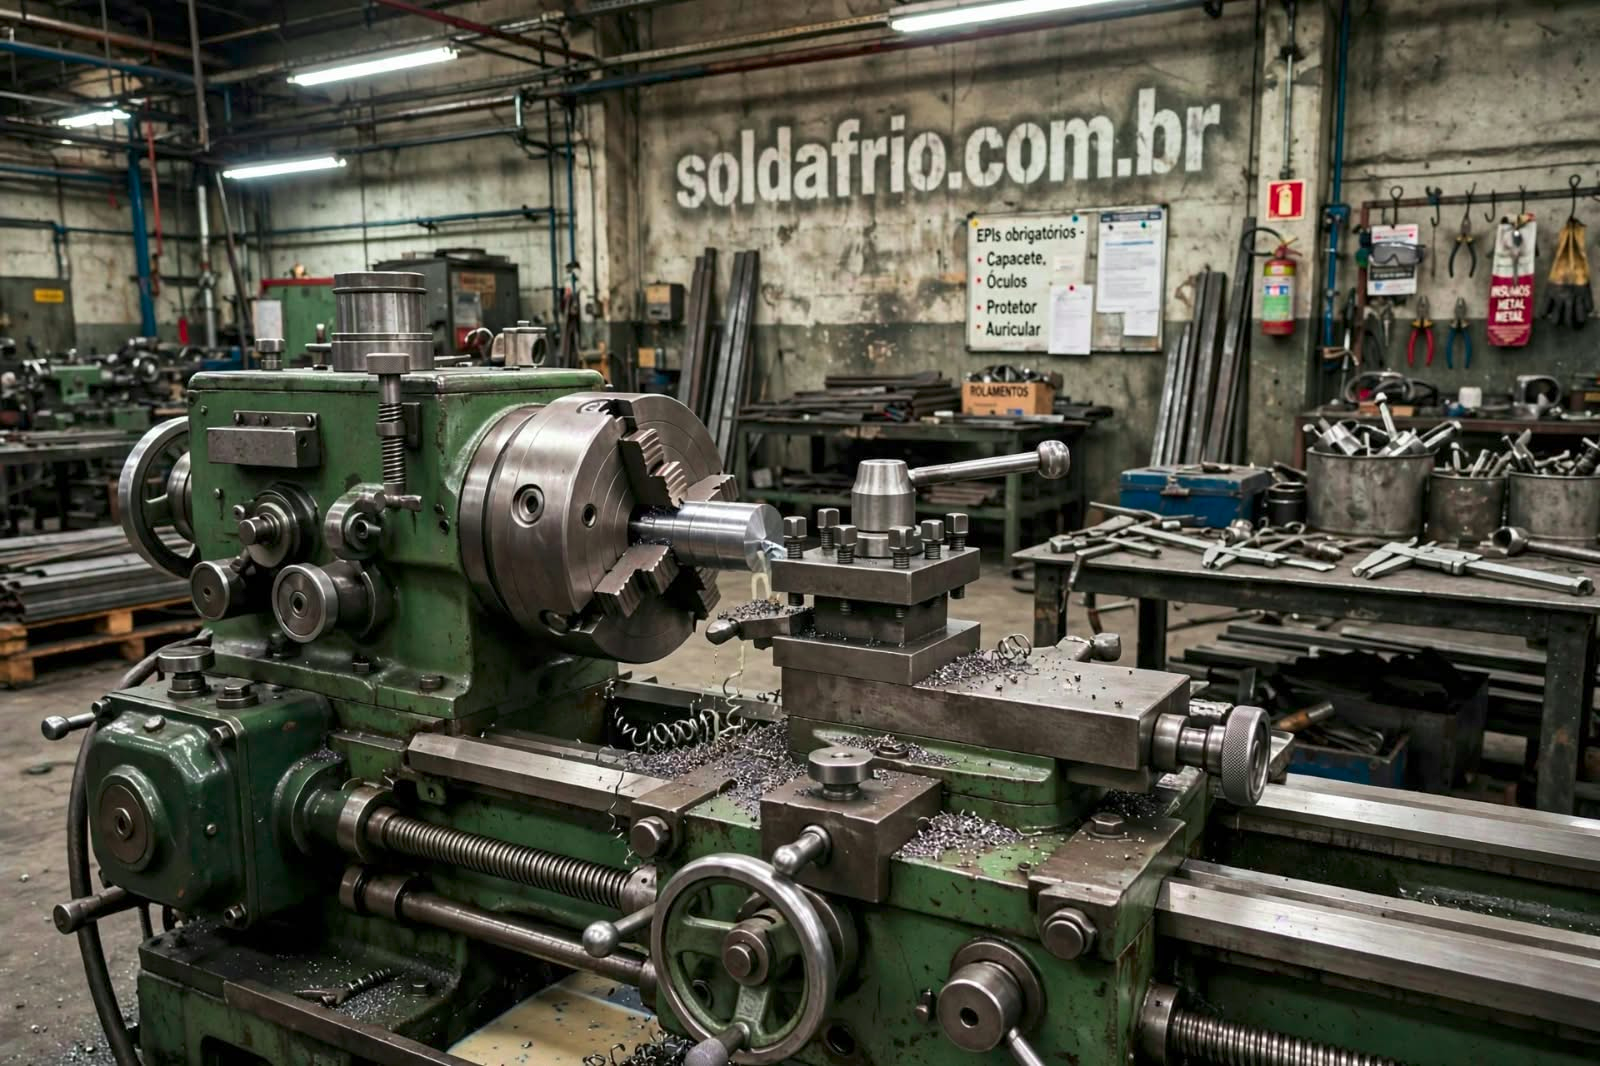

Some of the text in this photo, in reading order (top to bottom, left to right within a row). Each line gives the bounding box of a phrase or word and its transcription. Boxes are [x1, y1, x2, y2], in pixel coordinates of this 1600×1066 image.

[676, 87, 1221, 209] soldafrio.com.br
[976, 227, 1001, 243] EPIs
[1005, 224, 1076, 245] obrigatórios
[987, 270, 1027, 289] Óculos
[987, 299, 1037, 315] Protetor
[986, 322, 1041, 337] Auricular
[970, 385, 1029, 397] ROLAMENTOS
